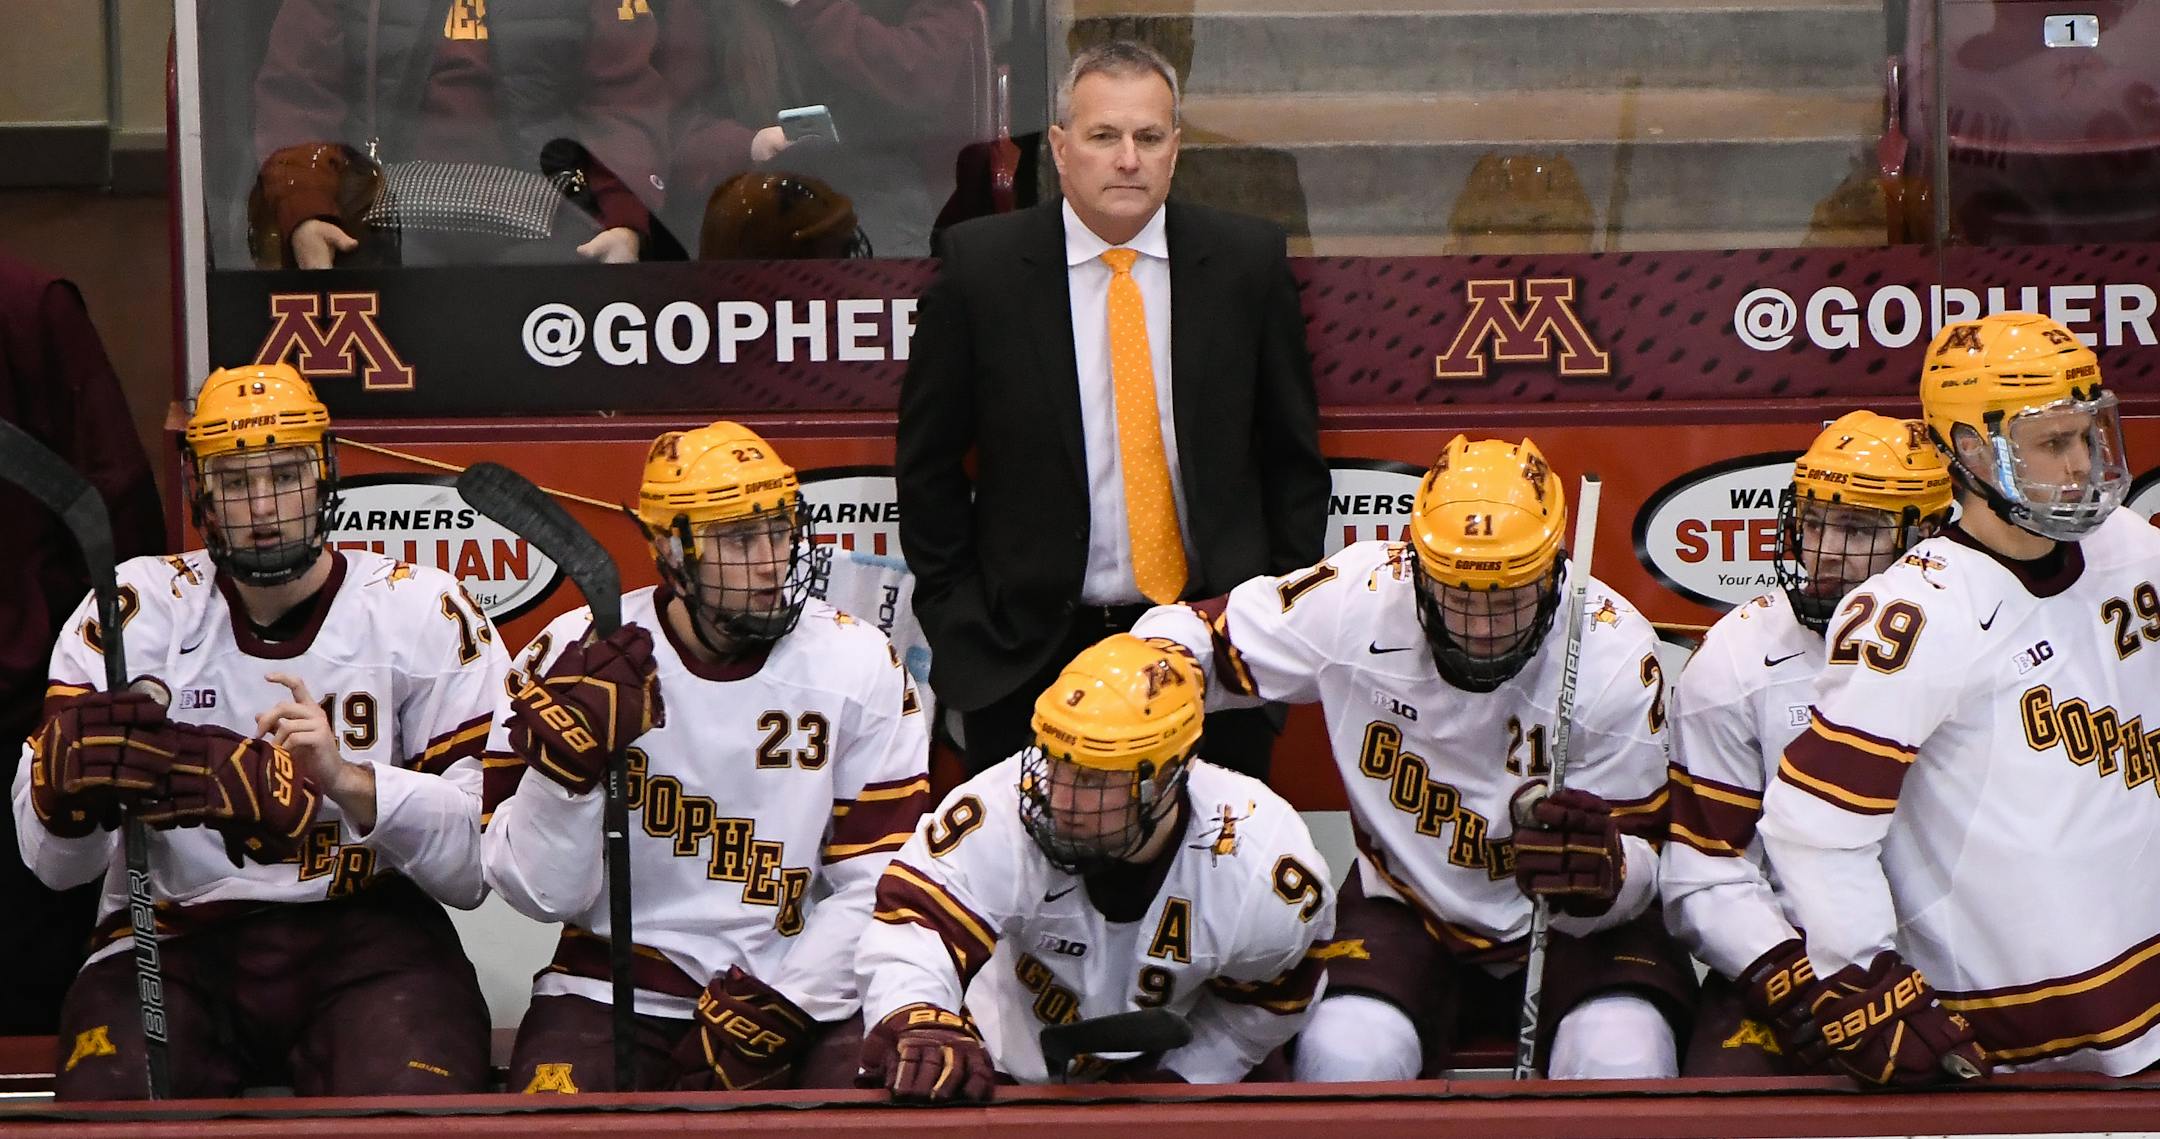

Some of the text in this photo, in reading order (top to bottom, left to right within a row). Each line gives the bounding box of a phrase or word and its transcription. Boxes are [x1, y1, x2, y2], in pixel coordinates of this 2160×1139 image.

[2065, 20, 2076, 41] 1
[1435, 278, 1609, 377] M
[2065, 364, 2096, 381] GOPHERS
[231, 414, 277, 431] GOPHERS
[1808, 468, 1849, 485] GOPHERS
[1464, 514, 1493, 536] 21
[1455, 560, 1502, 571] GOPHERS
[1718, 574, 1751, 586] Your
[1829, 592, 1928, 675] 29
[2101, 581, 2160, 661] 29
[756, 710, 830, 770] 23
[1789, 705, 1813, 727] B
[1504, 714, 1551, 777] 21
[925, 793, 987, 859] 9
[1271, 853, 1324, 924] 9
[127, 868, 168, 1043] BAUER
[1148, 896, 1192, 964] A
[1015, 952, 1082, 1024] GO
[1135, 964, 1177, 1009] 9
[907, 1009, 974, 1030] BA
